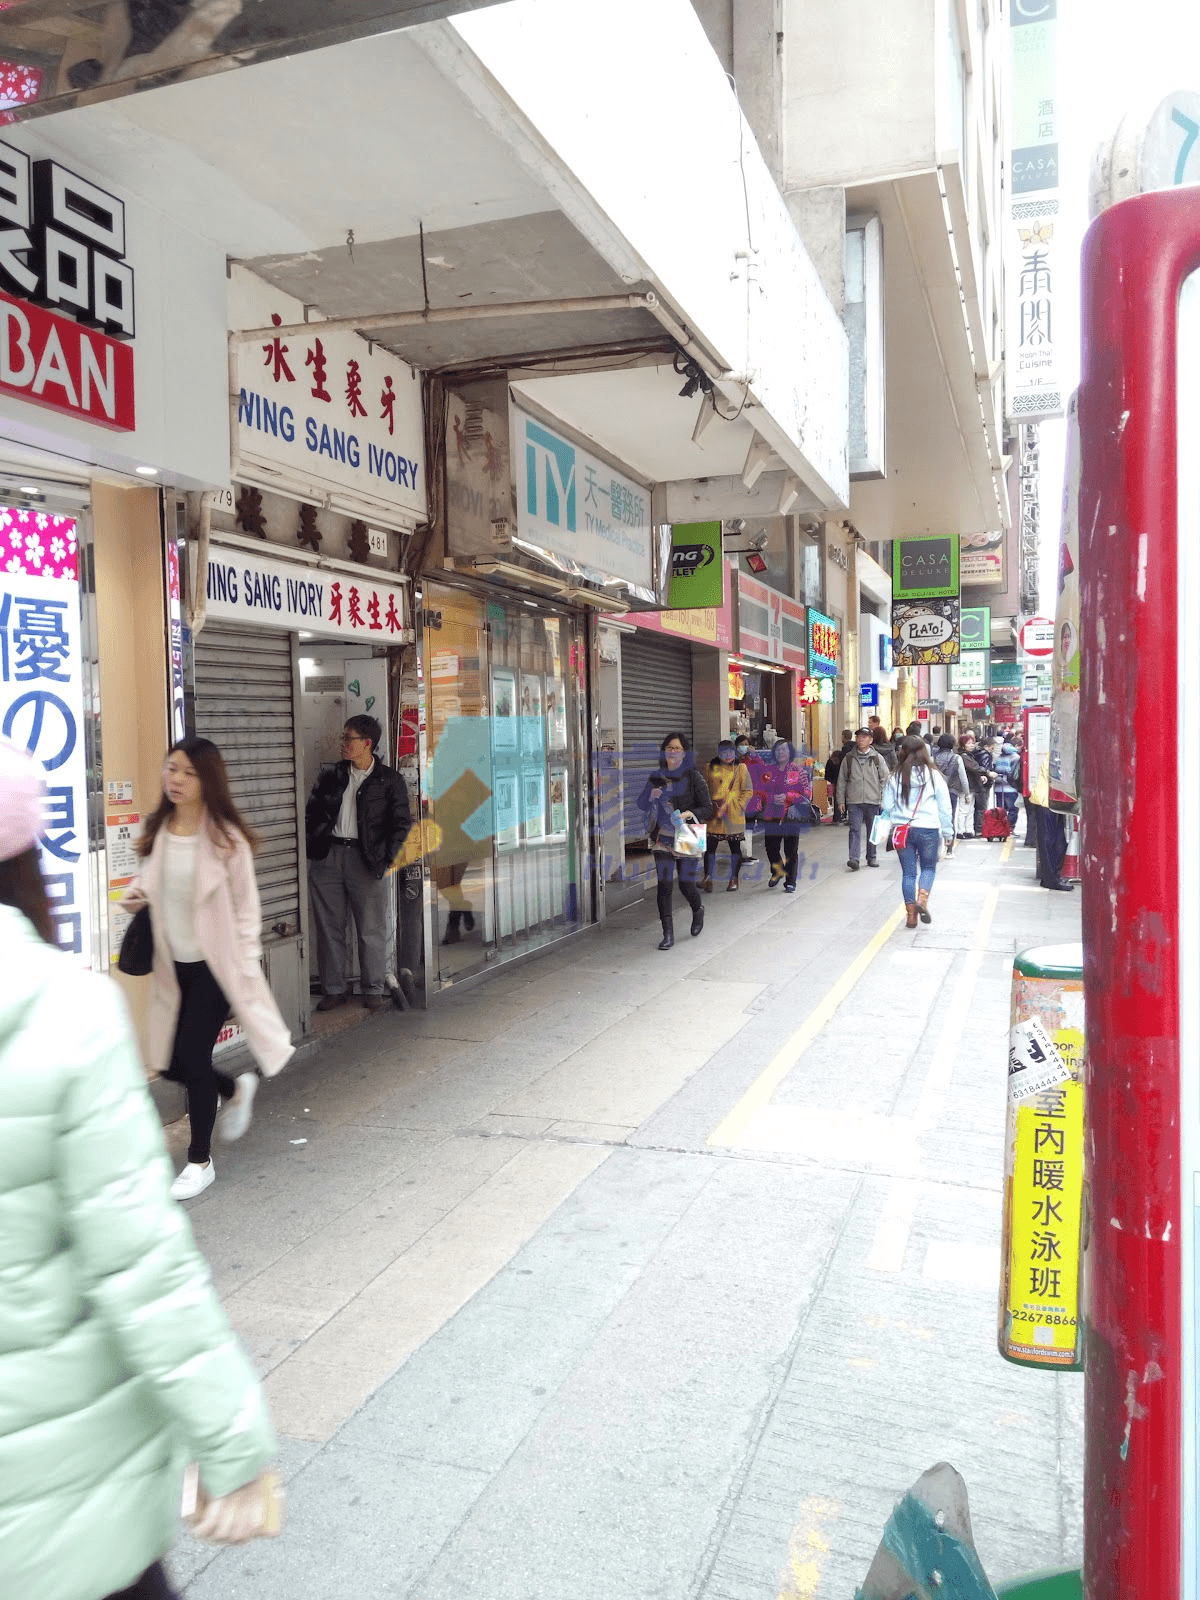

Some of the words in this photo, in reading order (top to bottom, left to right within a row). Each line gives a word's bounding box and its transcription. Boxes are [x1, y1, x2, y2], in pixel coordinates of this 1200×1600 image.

[1012, 157, 1056, 174] CASA
[1019, 359, 1053, 370] Cuisine
[1029, 377, 1043, 387] 1/F
[305, 416, 360, 468] SANG
[368, 442, 418, 491] IVORY
[584, 511, 596, 533] TY
[370, 535, 386, 550] 481
[901, 553, 950, 567] CASA
[902, 568, 950, 576] DELUXE
[244, 569, 282, 611] SANG
[286, 578, 324, 617] IVORY
[908, 621, 944, 640] PLATO!
[1013, 1075, 1058, 1099] 63184444
[1012, 1309, 1042, 1323] 2267
[1045, 1314, 1077, 1326] 8866
